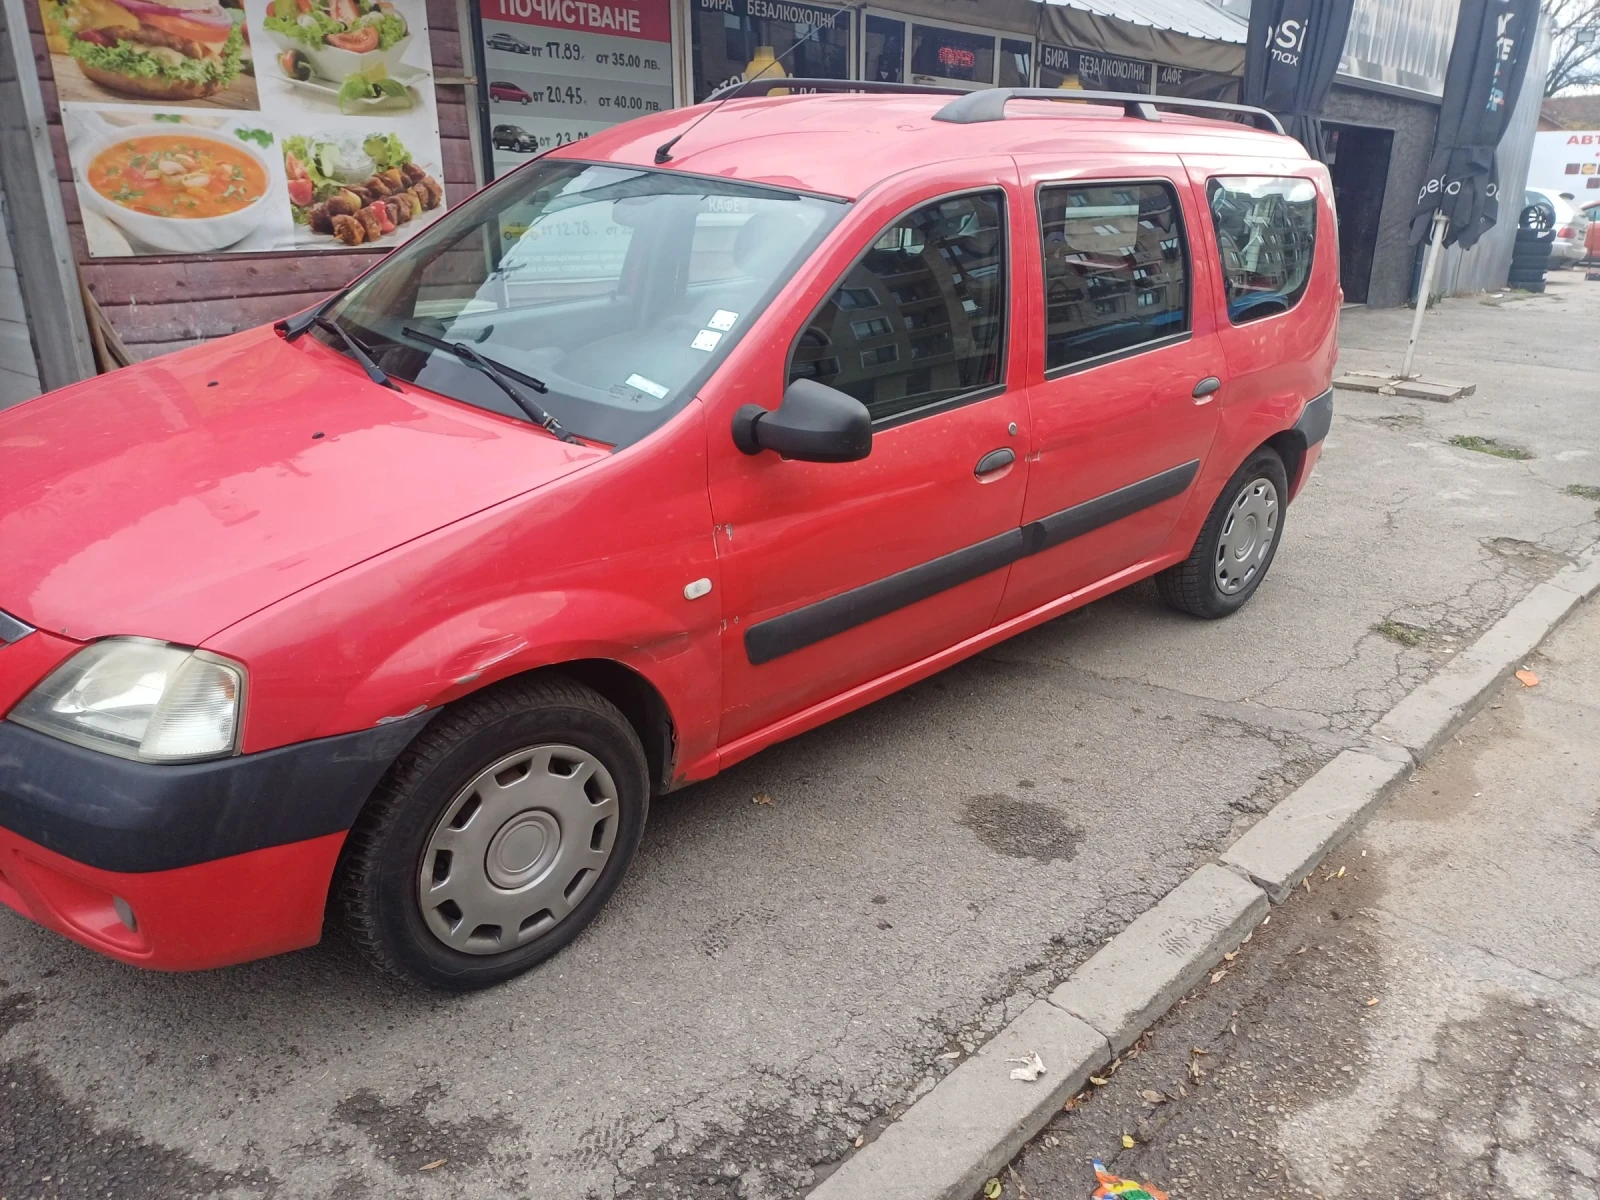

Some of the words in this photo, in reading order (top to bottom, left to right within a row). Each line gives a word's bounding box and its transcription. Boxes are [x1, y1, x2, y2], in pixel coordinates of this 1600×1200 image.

[500, 0, 641, 32] ПОЧИСТВАНЕ
[747, 0, 836, 29] БЕЗАЛКОХОЛНИ
[596, 54, 609, 65] от
[612, 52, 641, 68] 35.00
[643, 59, 661, 71] лв.
[1045, 47, 1069, 69] БИРА
[1079, 54, 1145, 81] БЕЗАЛКОХОЛНИ
[1162, 67, 1183, 85] КАФЕ
[533, 91, 544, 102] от
[547, 86, 582, 104] 20.45
[598, 97, 611, 107] от
[614, 95, 643, 110] 40.00
[645, 101, 661, 111] лв.
[539, 136, 551, 147] от
[708, 198, 740, 212] КАФЕ
